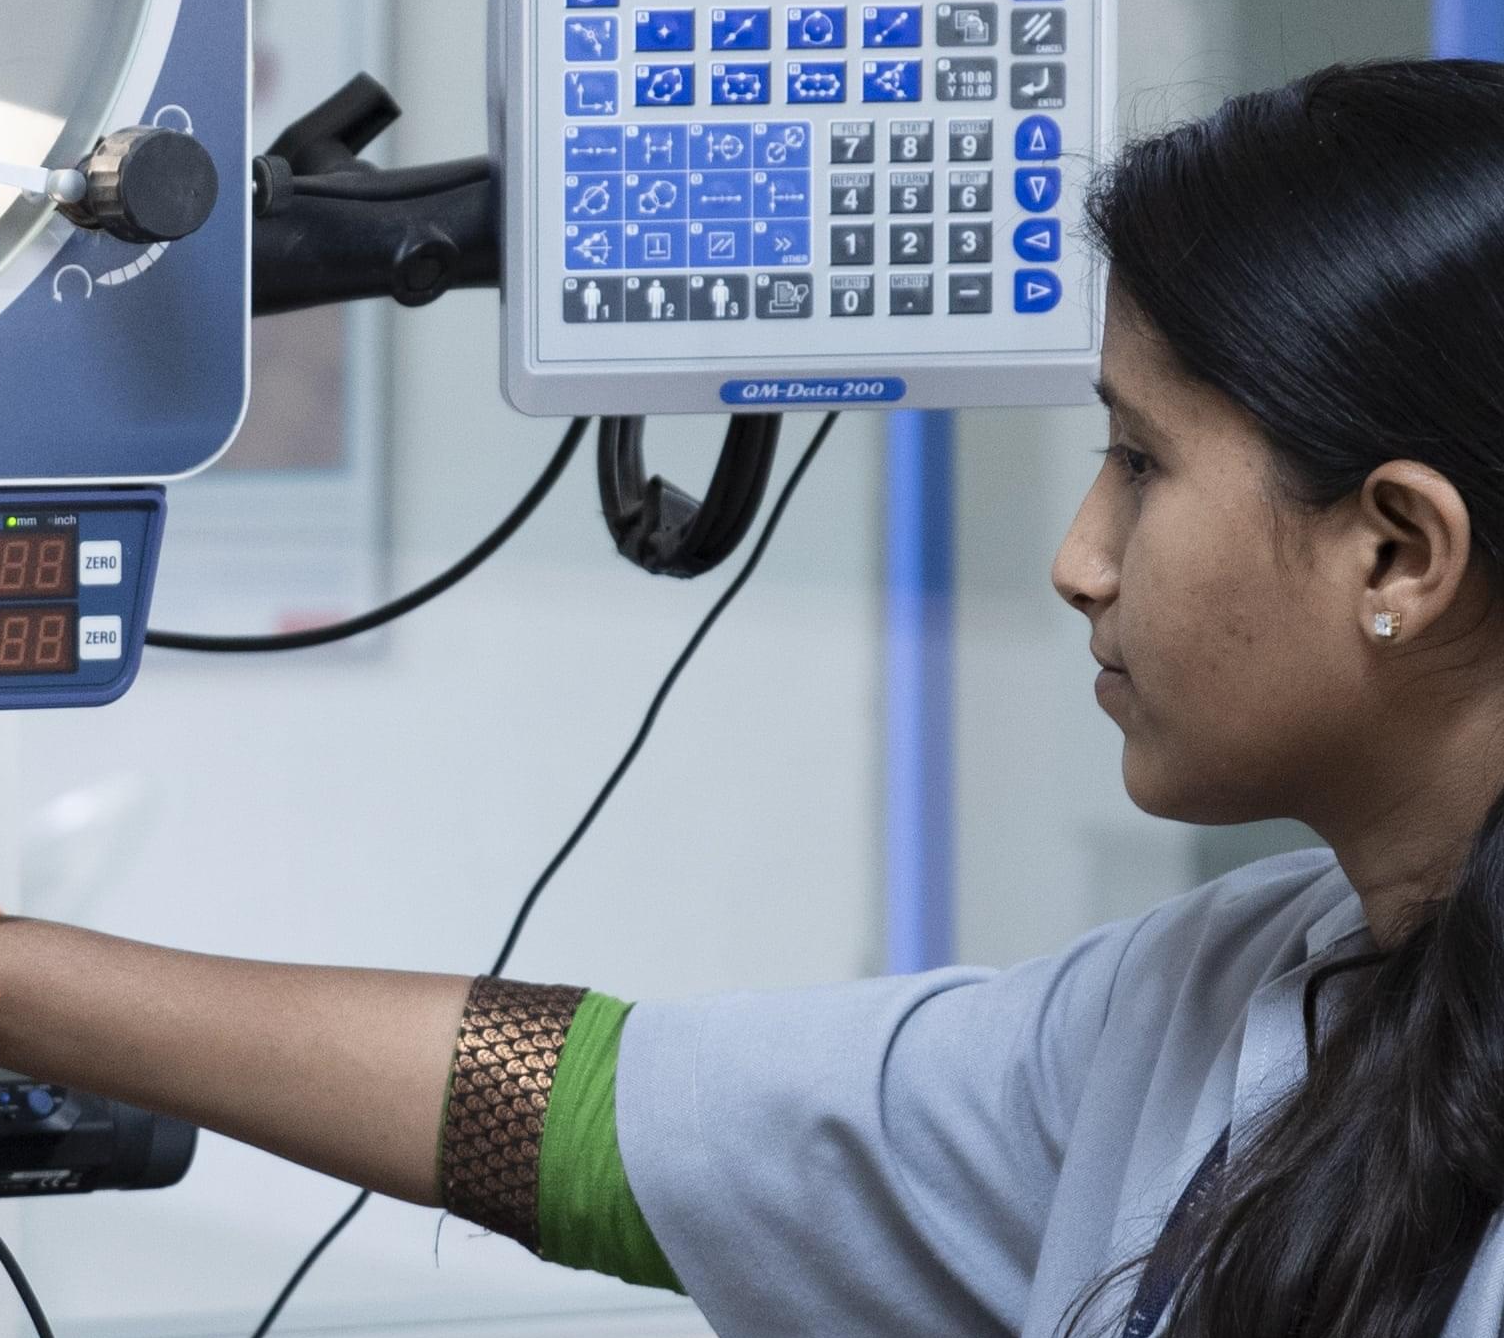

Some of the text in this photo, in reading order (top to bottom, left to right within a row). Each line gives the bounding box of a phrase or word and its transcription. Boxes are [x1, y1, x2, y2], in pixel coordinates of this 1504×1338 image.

[1035, 44, 1063, 54] CANCEL
[570, 73, 580, 85] Y
[948, 71, 992, 83] X 10.00
[948, 84, 992, 97] Y 10.00
[605, 101, 614, 112] X
[1037, 98, 1063, 108] ENTER
[841, 124, 862, 134] FILE
[899, 123, 922, 134] STAT
[951, 123, 987, 134] SYSTEM
[844, 137, 860, 159] 7
[903, 136, 918, 158] 8
[962, 135, 977, 157] 9
[833, 175, 870, 186] REPEAT
[894, 174, 926, 185] LEARN
[959, 174, 980, 184] EDIT
[843, 189, 858, 210] 4
[903, 188, 918, 209] 5
[961, 186, 977, 208] 6
[845, 232, 857, 255] 1
[903, 232, 918, 253] 2
[961, 231, 977, 253] 3
[843, 290, 859, 312] 0
[602, 306, 609, 318] 1
[665, 303, 675, 317] 2
[730, 302, 739, 315] 3
[742, 382, 885, 399] QM-Data 200
[17, 514, 77, 527] mm inch
[85, 555, 117, 569] ZERO
[85, 630, 117, 644] ZERO
